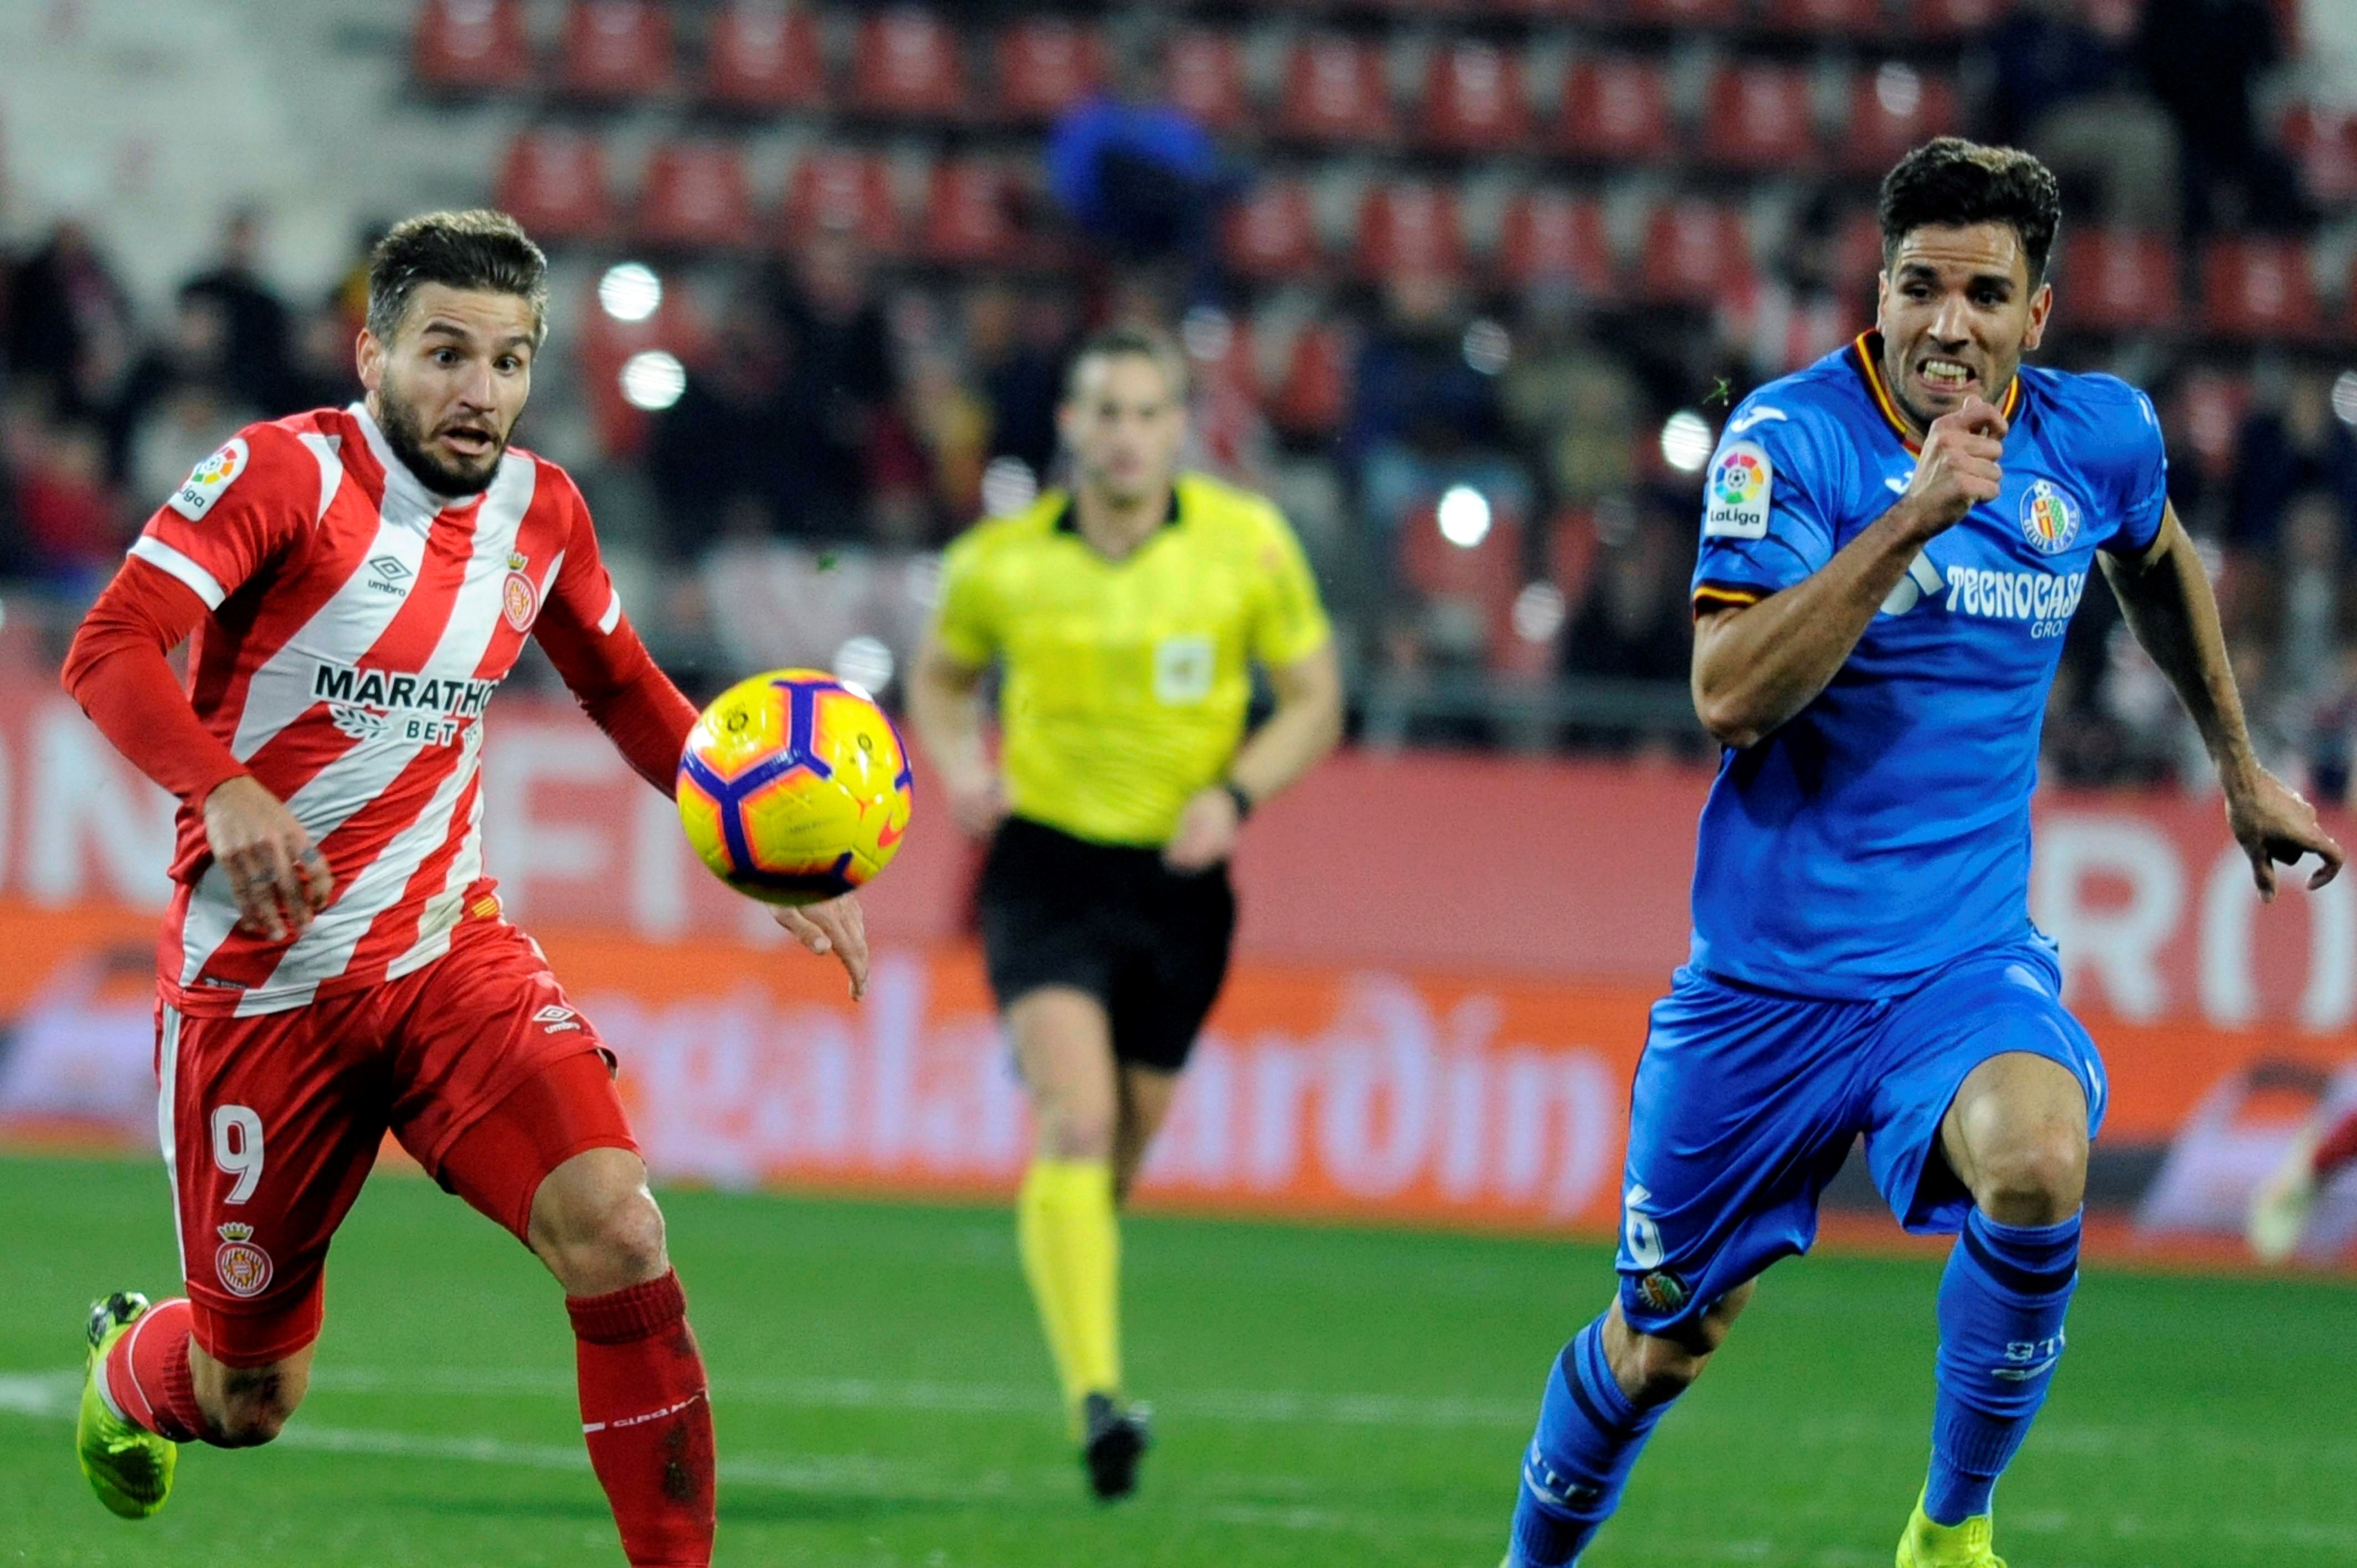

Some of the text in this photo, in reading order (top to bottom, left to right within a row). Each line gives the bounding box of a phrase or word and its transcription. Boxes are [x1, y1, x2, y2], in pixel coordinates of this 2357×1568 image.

[1710, 508, 1761, 526] LaLiga
[368, 579, 406, 597] umbro
[406, 720, 455, 742] BET
[210, 1104, 264, 1204] 9
[1625, 1184, 1664, 1268] 6
